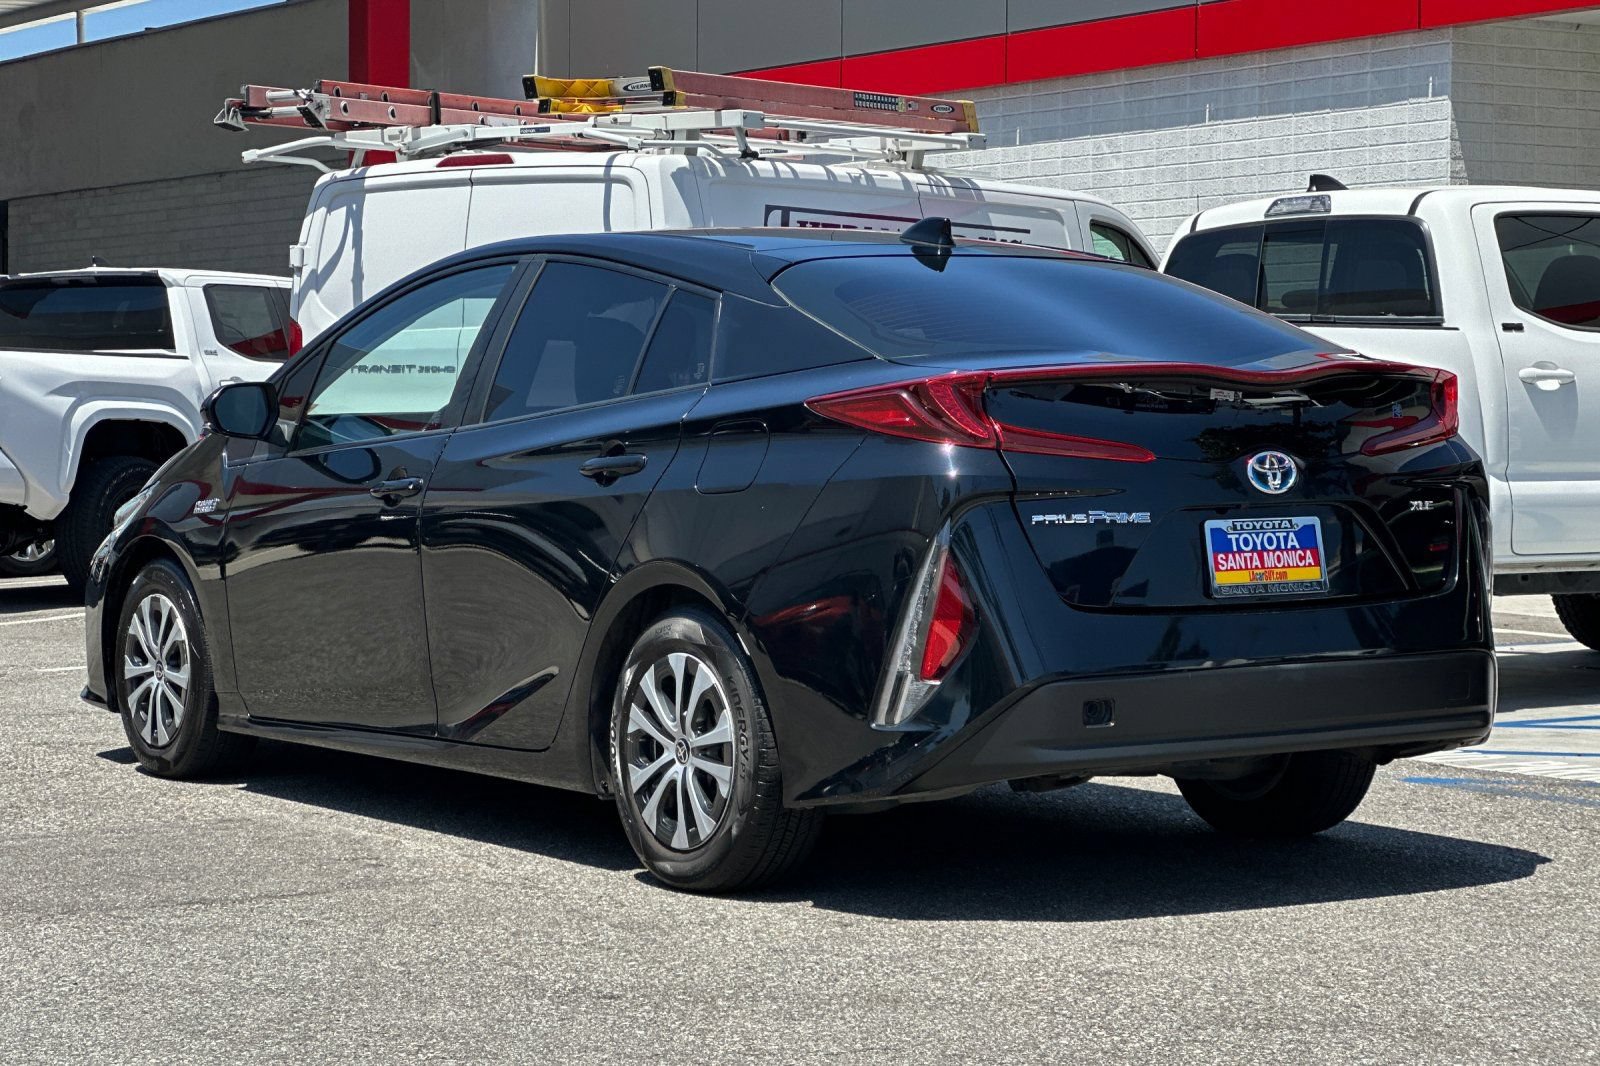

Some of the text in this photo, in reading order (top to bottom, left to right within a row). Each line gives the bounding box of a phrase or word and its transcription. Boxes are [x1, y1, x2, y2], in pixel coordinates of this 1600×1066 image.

[351, 365, 416, 374] TRANSIT
[1410, 500, 1434, 510] XLE
[1031, 510, 1151, 524] PRIUS PRIME
[1233, 520, 1291, 530] TOYOTA
[1228, 532, 1300, 552] TOYOTA
[1218, 550, 1314, 570] SANTA MONICA
[1221, 582, 1321, 595] SANTA MONICA
